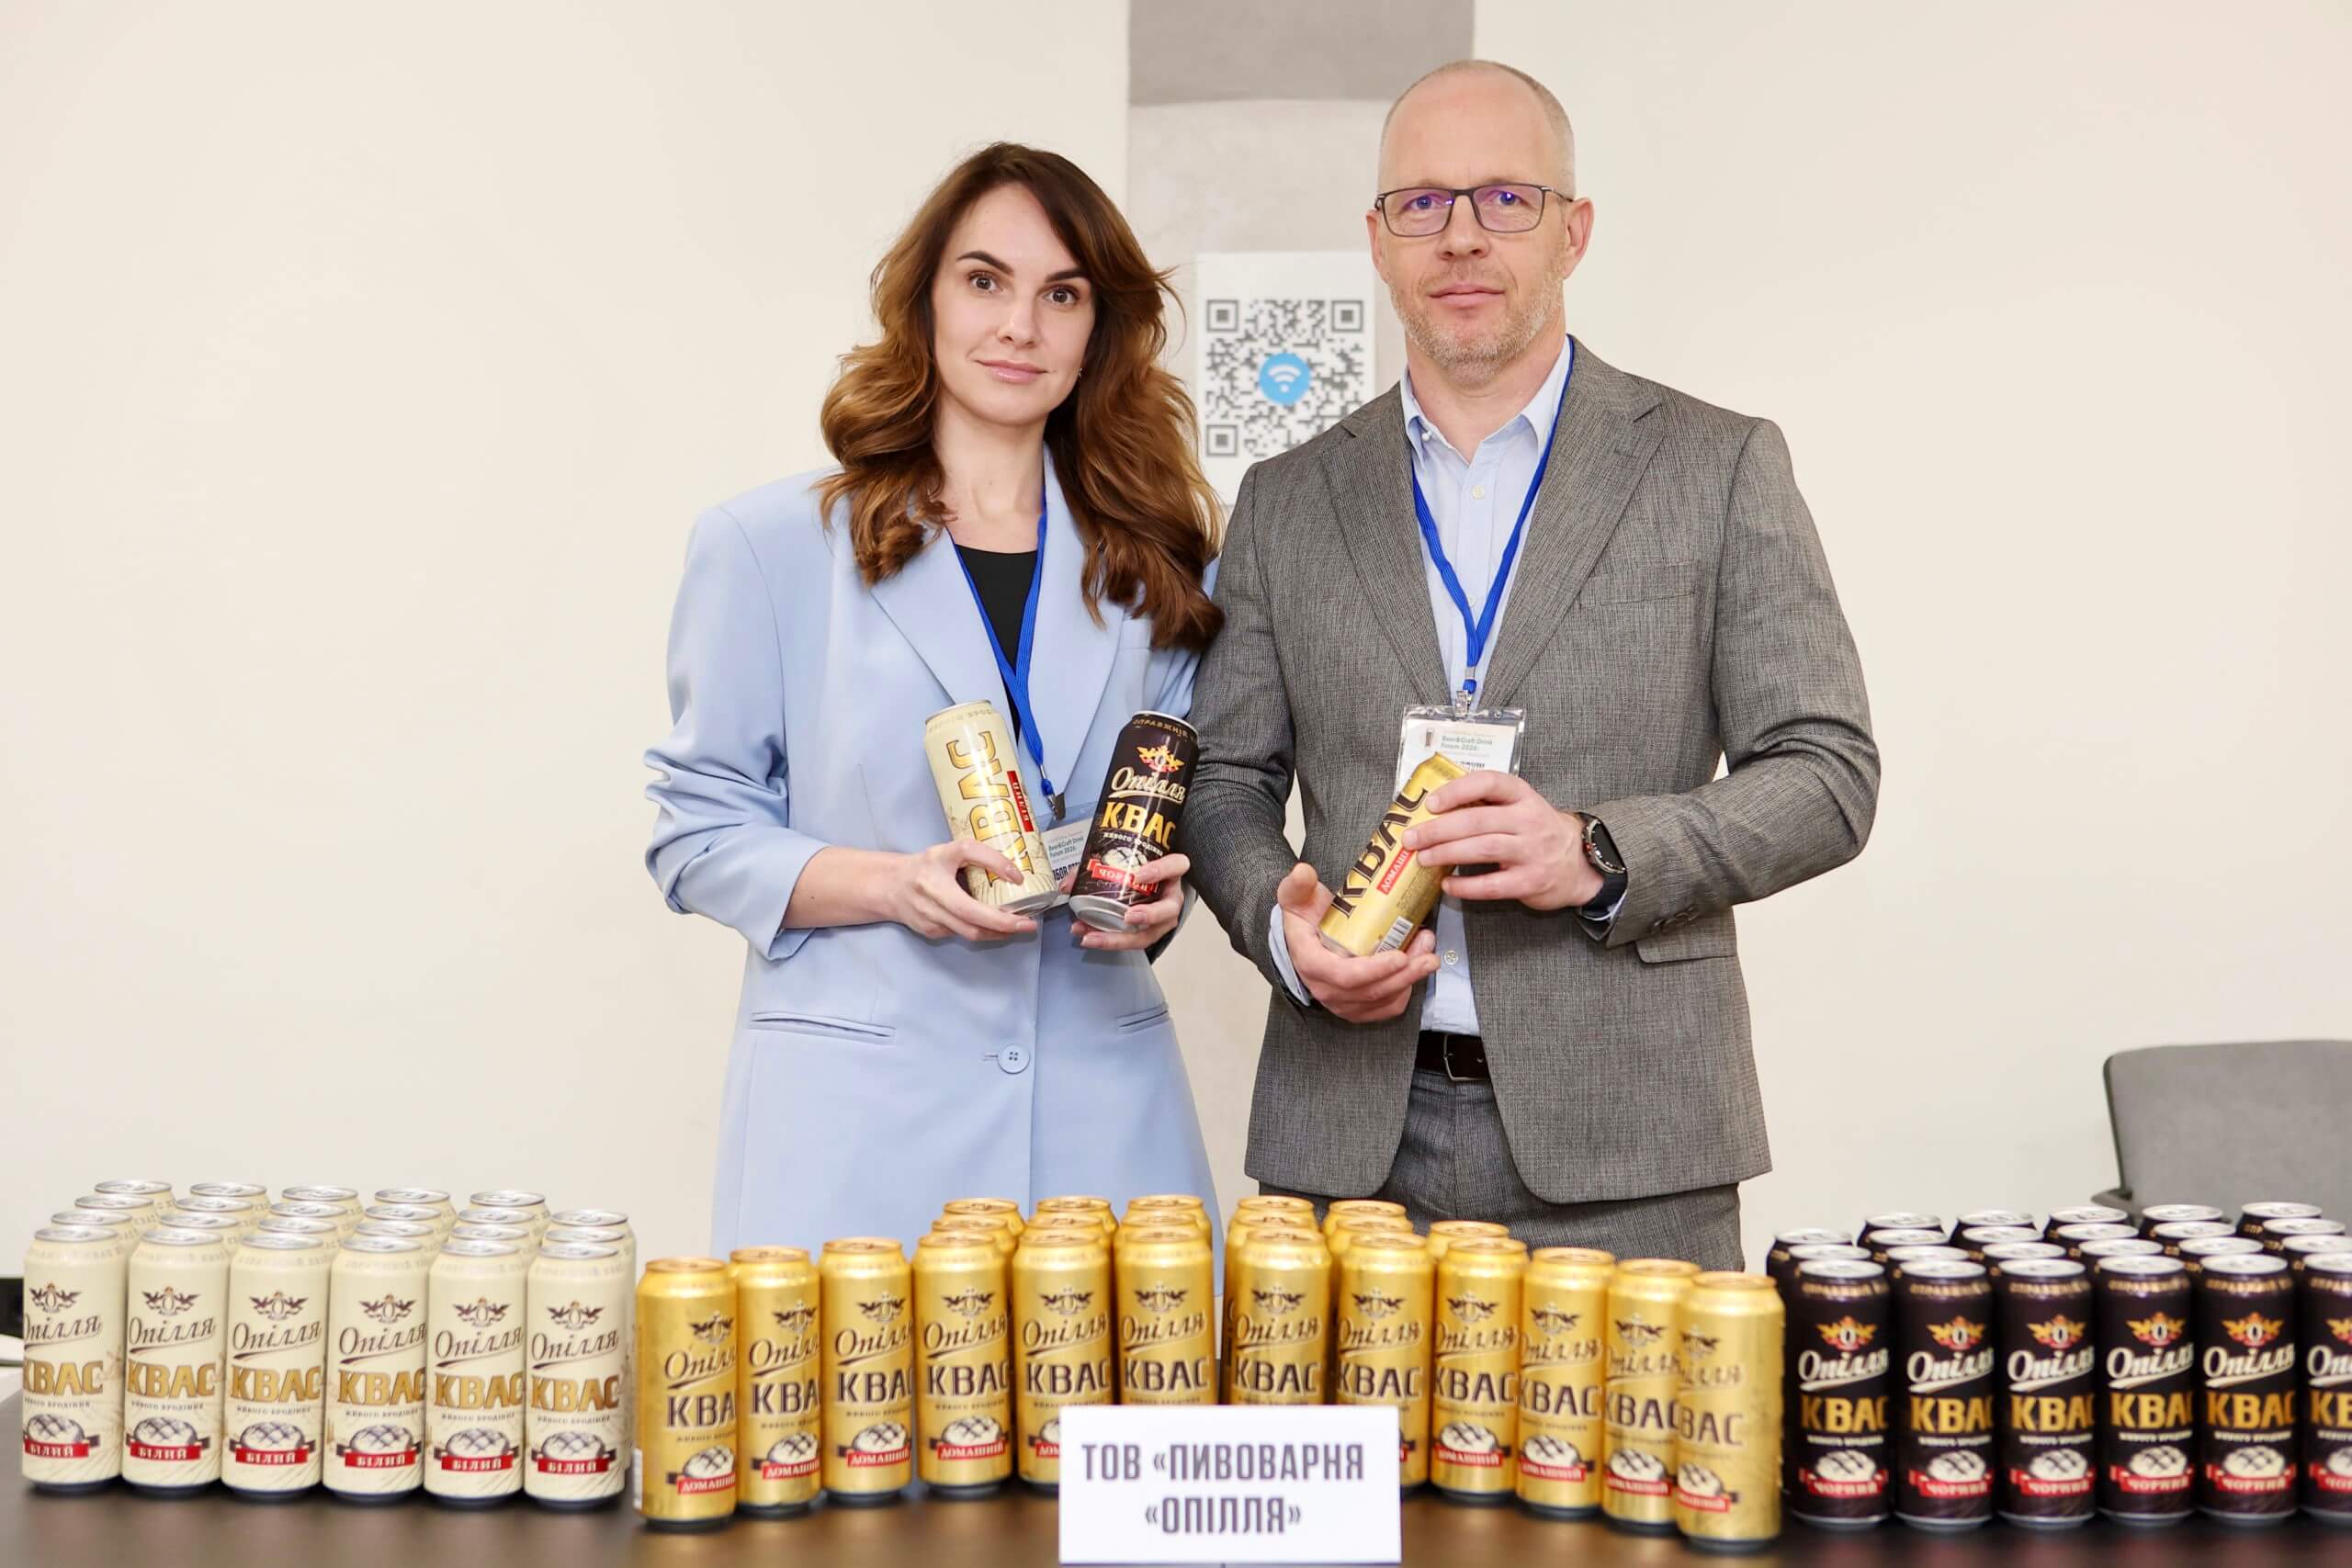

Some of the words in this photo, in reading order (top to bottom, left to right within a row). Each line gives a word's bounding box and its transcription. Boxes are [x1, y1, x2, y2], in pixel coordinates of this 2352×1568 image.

[1111, 766, 1186, 801] Опілля
[1100, 801, 1176, 851] КВАС
[1381, 851, 1409, 893] ДОМАШ
[130, 1316, 216, 1345] Опілля
[232, 1320, 322, 1350] Опілля
[339, 1322, 426, 1355] Опілля
[435, 1326, 523, 1359] Опілля
[532, 1329, 619, 1360] Опілля
[127, 1359, 216, 1398] КВАС
[1026, 1358, 1110, 1394] КВАС
[1124, 1357, 1208, 1392] КВАС
[1235, 1356, 1319, 1393] КВАС
[2203, 1343, 2295, 1378] Опілля
[231, 1364, 321, 1403] КВАС
[338, 1367, 425, 1406] КВАС
[434, 1371, 523, 1410] КВАС
[531, 1373, 619, 1412] КВАС
[752, 1378, 820, 1414] КВА
[667, 1391, 735, 1427] КВА
[1680, 1405, 1743, 1446] ВАС
[2312, 1391, 2352, 1429] КВ
[29, 1445, 74, 1457] БІЛИЙ
[138, 1447, 188, 1459] БІЛИЙ
[245, 1451, 297, 1463] БІЛИЙ
[356, 1454, 406, 1467] БІЛИЙ
[452, 1458, 503, 1471] БІЛИЙ
[548, 1461, 597, 1472] БІЛИЙ
[1081, 1444, 1141, 1481] ТОВ
[1153, 1444, 1364, 1481] «ПИВОВАРНЯ
[1146, 1496, 1301, 1533] «ОПІЛЛЯ»
